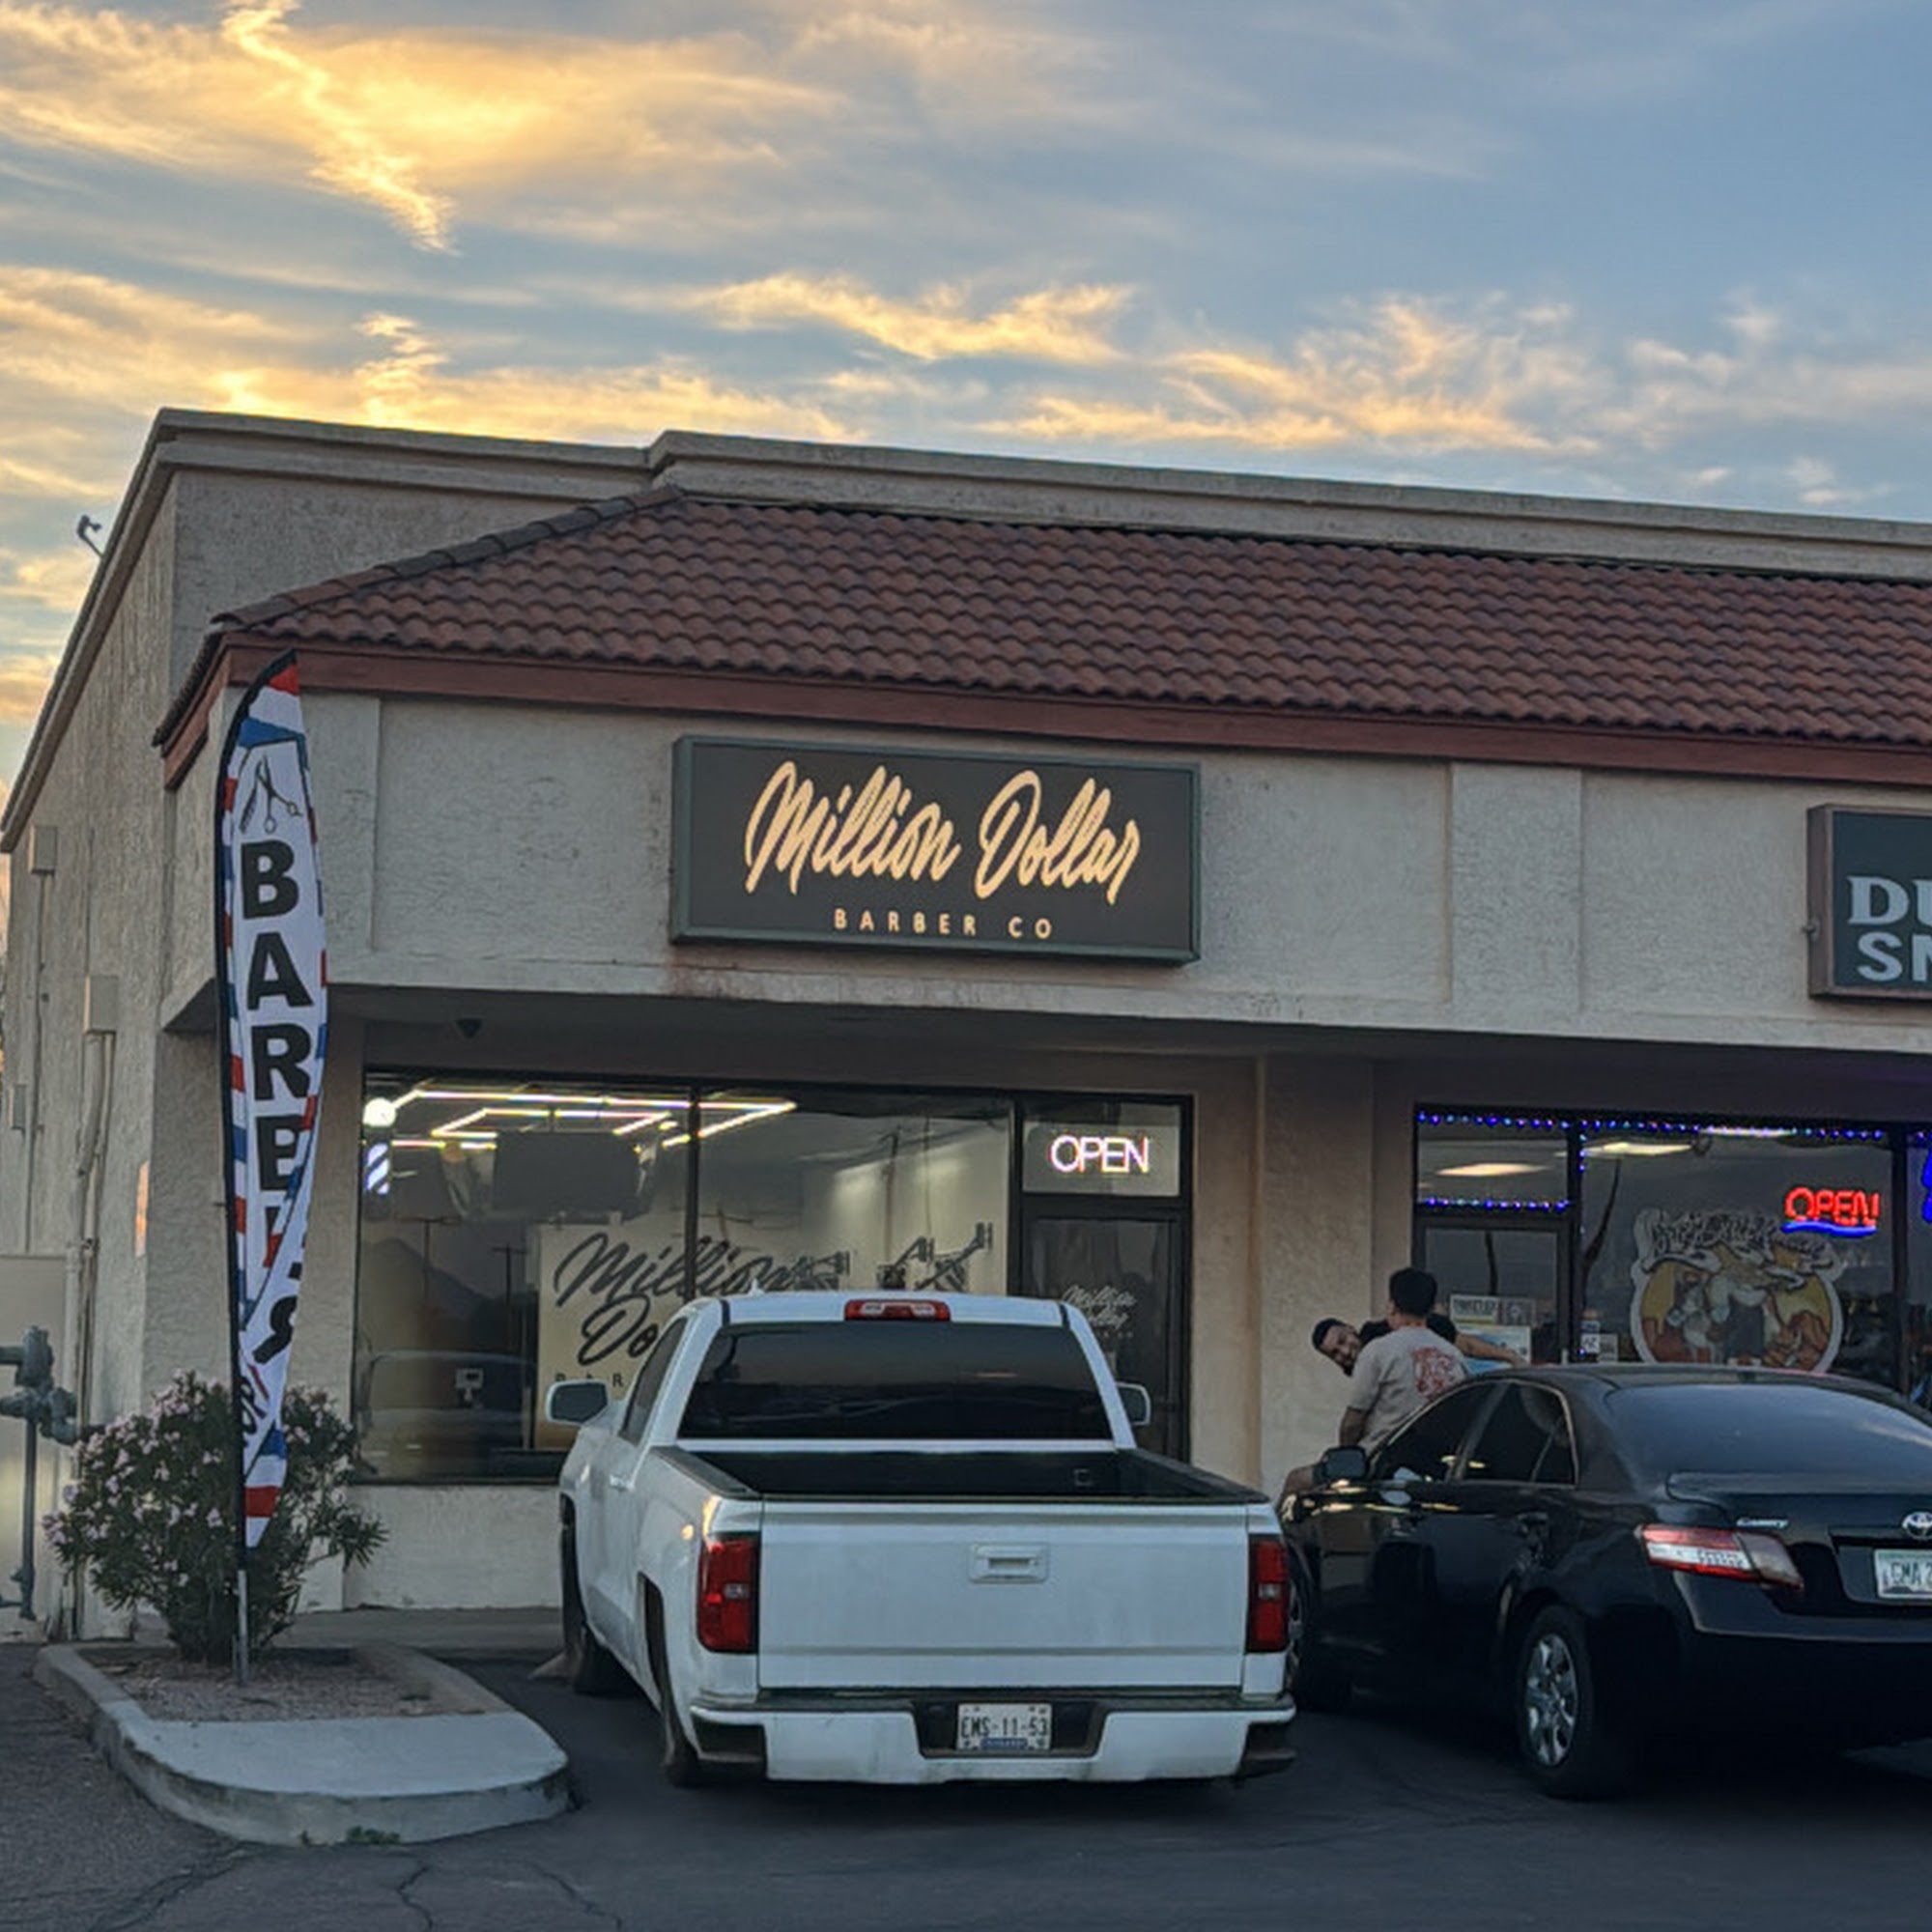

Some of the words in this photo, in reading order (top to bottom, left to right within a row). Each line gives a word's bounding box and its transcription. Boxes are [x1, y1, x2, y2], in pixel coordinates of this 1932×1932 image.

[745, 760, 961, 895] Million
[975, 770, 1140, 904] Dollar
[834, 907, 976, 937] BARBER
[1008, 917, 1053, 940] CO
[1050, 1133, 1150, 1175] OPEN
[1784, 1185, 1881, 1227] OPEN
